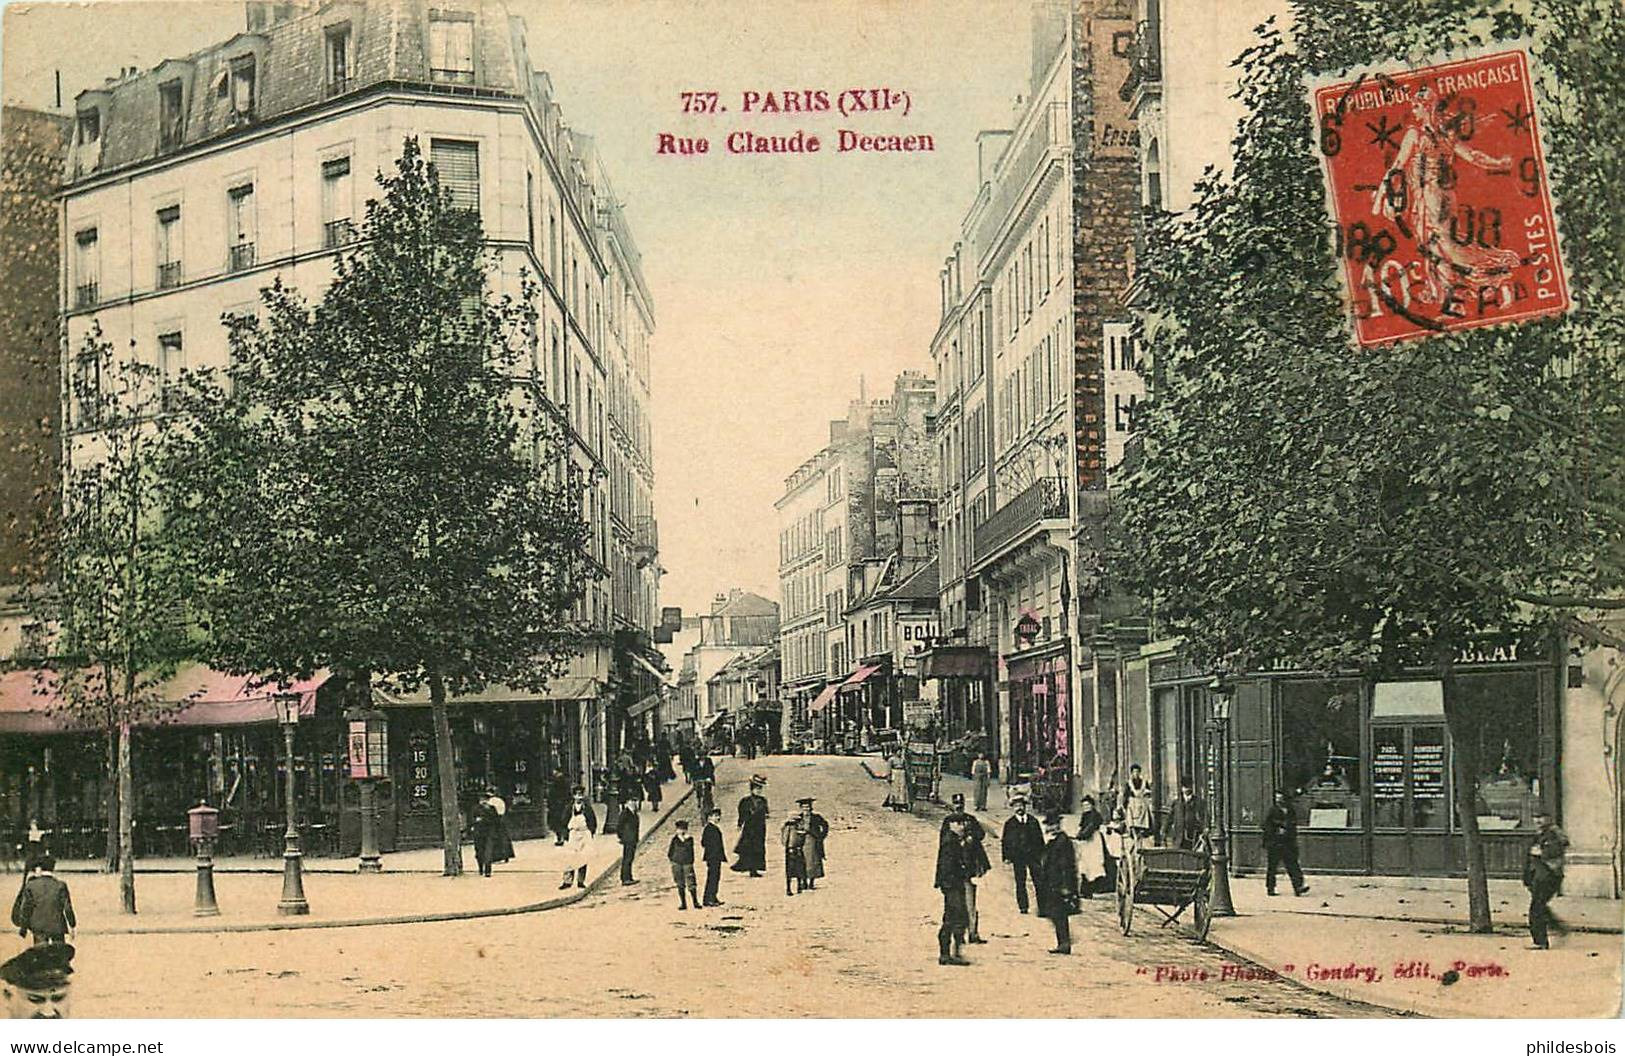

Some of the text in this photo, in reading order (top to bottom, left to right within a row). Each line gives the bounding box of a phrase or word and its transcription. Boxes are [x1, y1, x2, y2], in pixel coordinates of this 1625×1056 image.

[1437, 63, 1519, 95] FRANÇAISE
[1524, 213, 1557, 300] POSTES
[413, 751, 426, 763] 15
[415, 767, 427, 780] 20
[413, 785, 428, 797] 25
